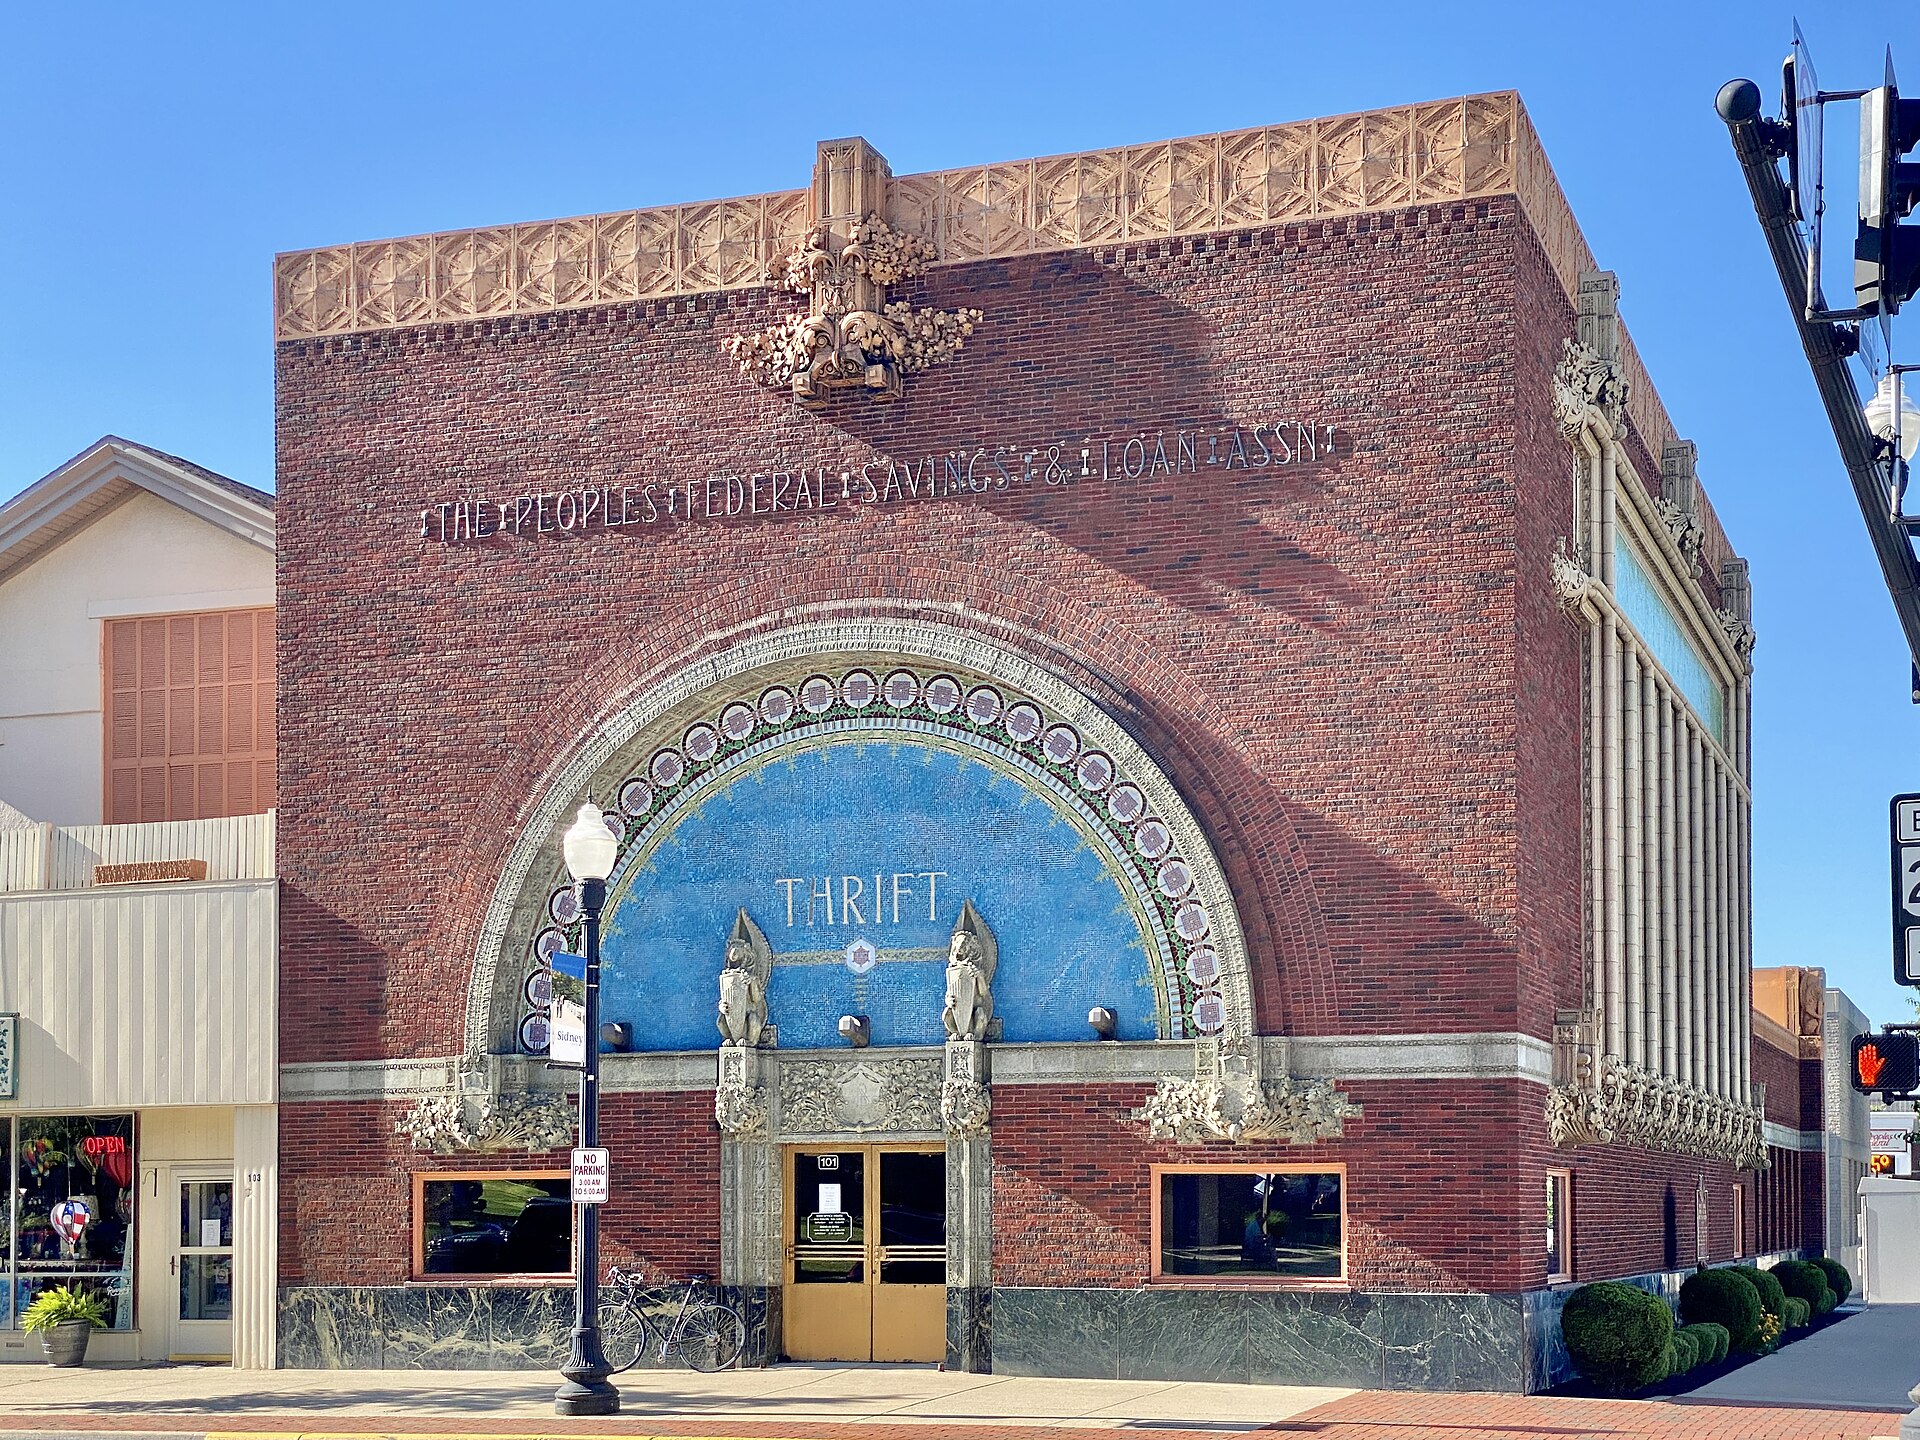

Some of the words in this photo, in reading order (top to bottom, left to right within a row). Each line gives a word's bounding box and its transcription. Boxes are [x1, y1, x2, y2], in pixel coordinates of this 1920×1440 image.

[435, 500, 492, 541] THE
[515, 484, 657, 534] PEOPLES
[687, 468, 837, 518] FEDERAL
[861, 451, 1010, 503] SAVINGS
[1045, 446, 1068, 486] &
[1103, 432, 1197, 481] LOAN
[1226, 420, 1316, 470] ASSN
[775, 872, 948, 927] THRIFT
[557, 1030, 584, 1046] Sidney
[86, 1136, 125, 1153] OPEN
[583, 1153, 597, 1165] NO
[820, 1157, 837, 1168] 101
[574, 1165, 606, 1176] PARKING
[248, 1173, 261, 1182] 103
[592, 1178, 601, 1186] AM
[575, 1187, 583, 1195] TO
[596, 1187, 606, 1195] AM
